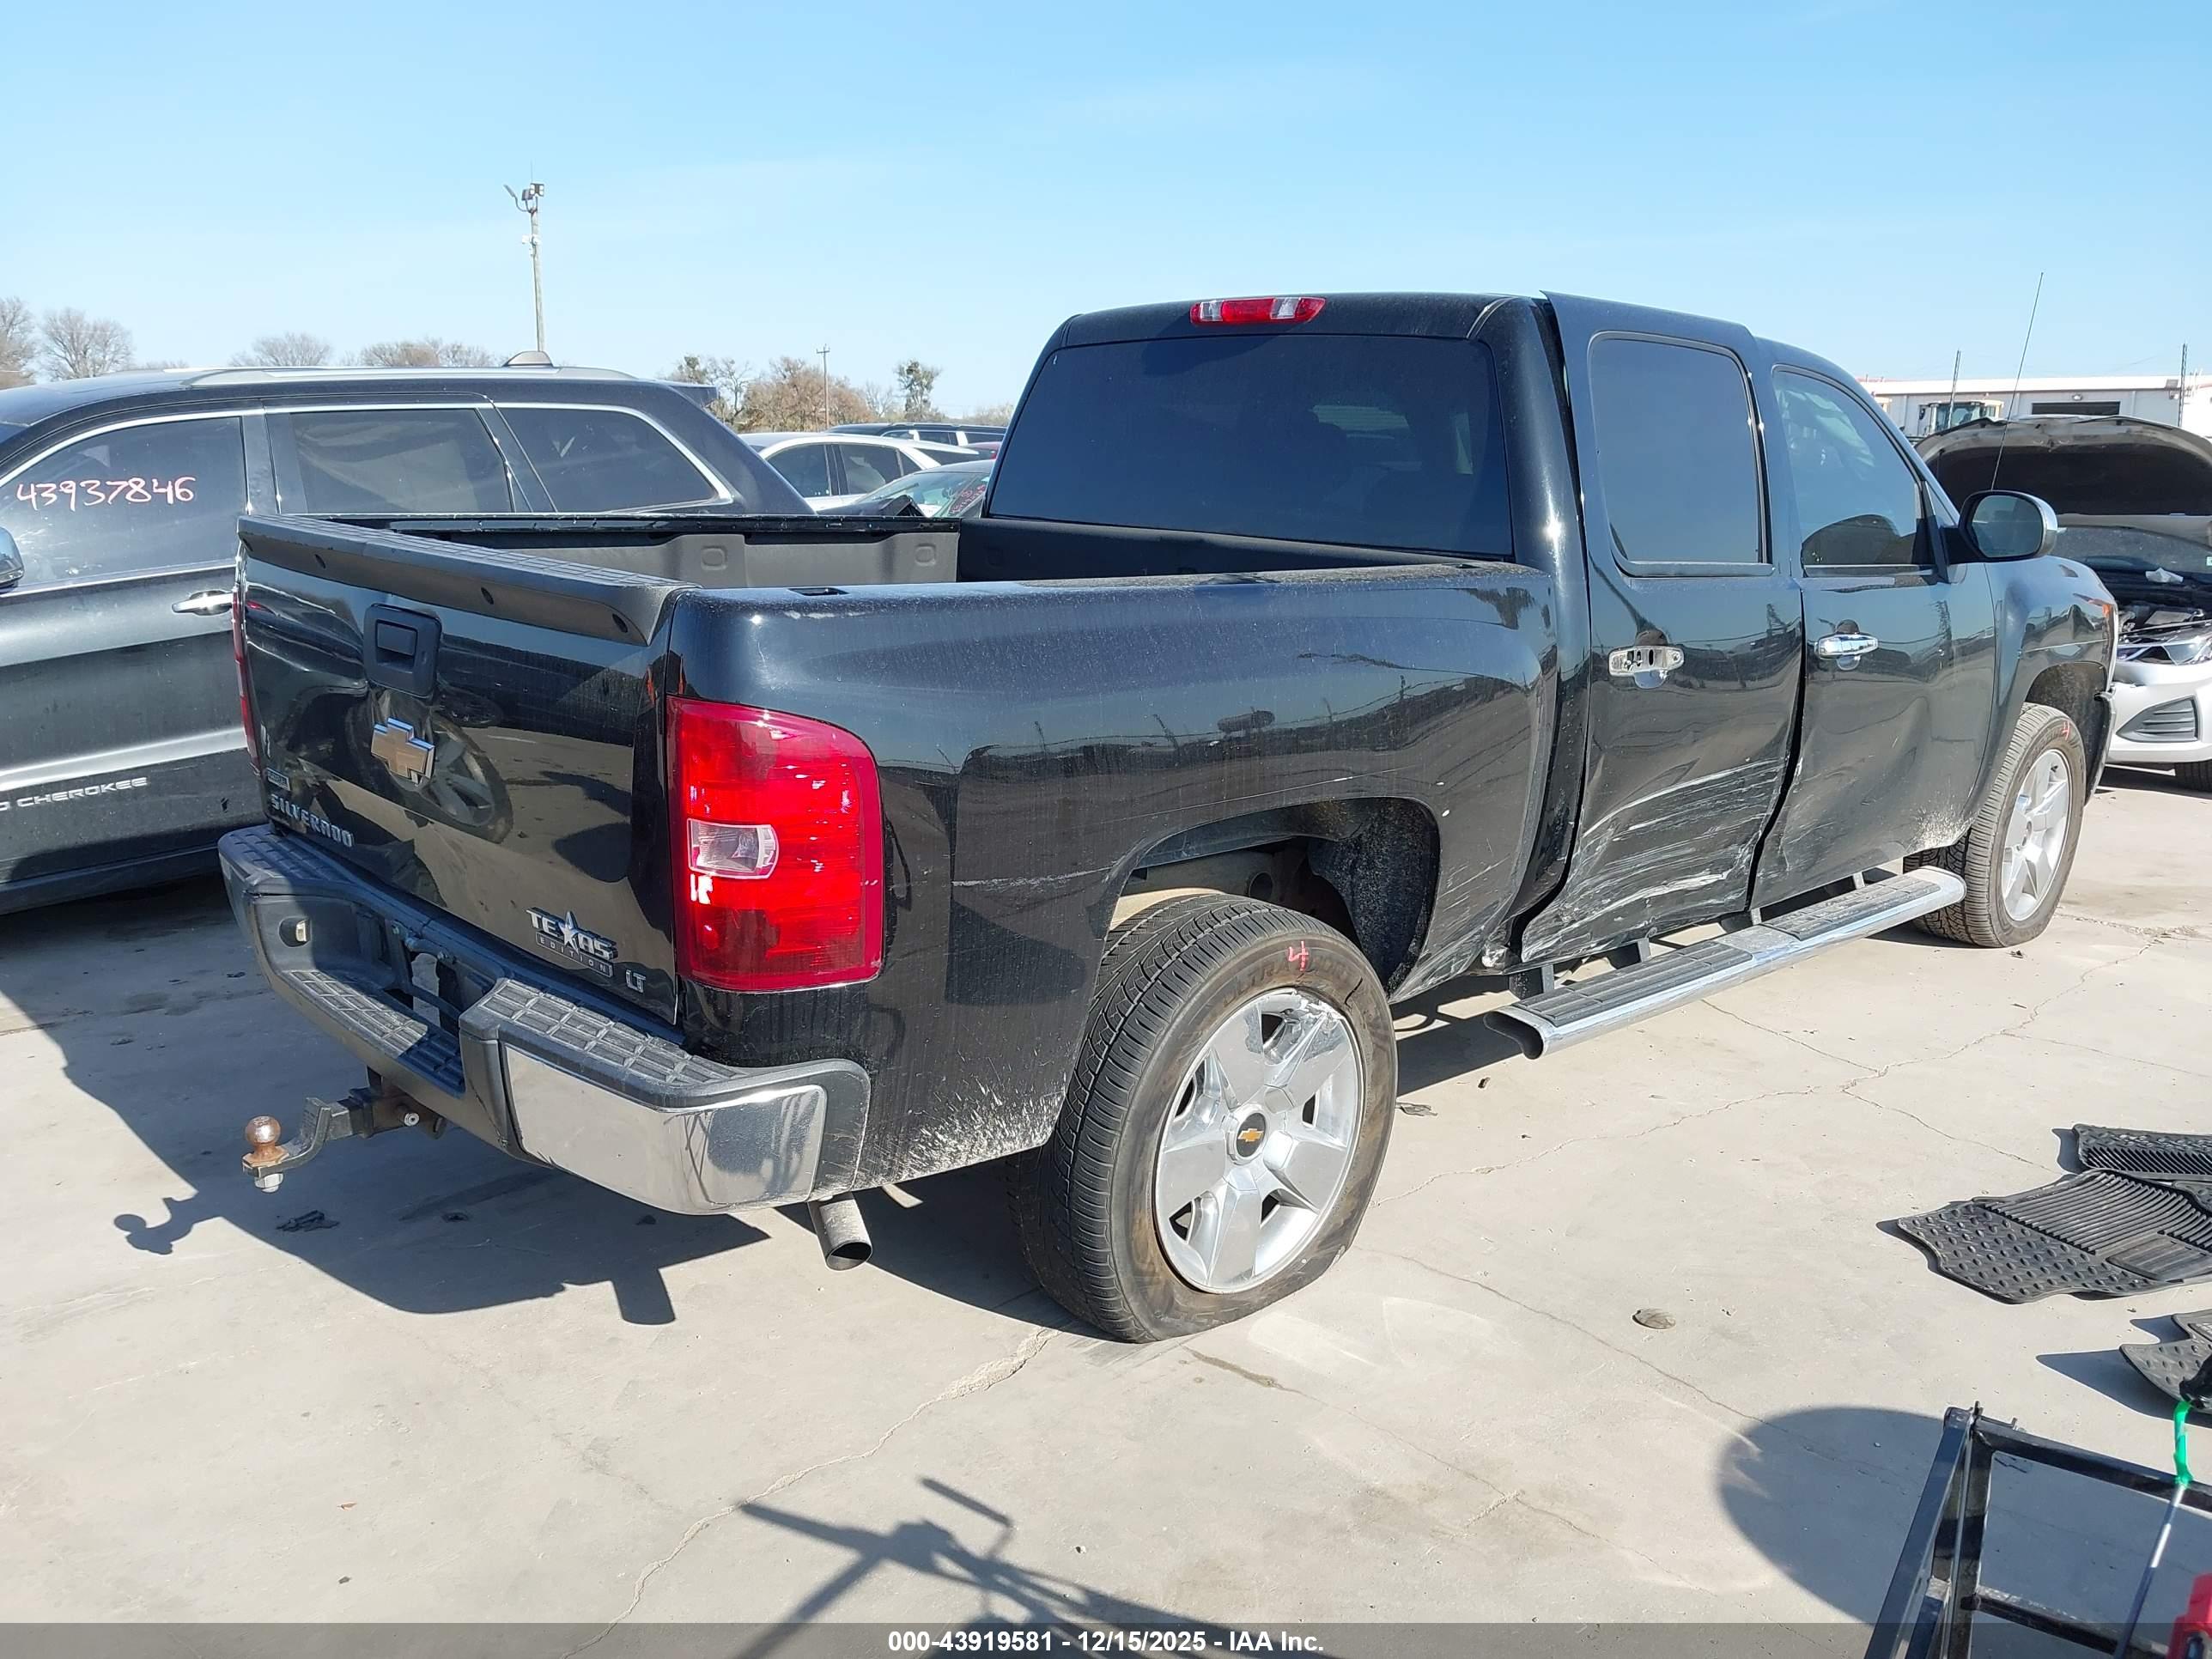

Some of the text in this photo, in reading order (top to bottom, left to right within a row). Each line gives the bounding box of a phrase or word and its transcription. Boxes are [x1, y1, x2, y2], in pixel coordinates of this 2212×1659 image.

[15, 476, 197, 512] 43937846
[16, 776, 149, 808] CHEROKEE
[270, 793, 354, 848] SILVERADO
[539, 936, 607, 974] EDITION
[1287, 940, 1310, 972] 4
[625, 969, 647, 994] LT
